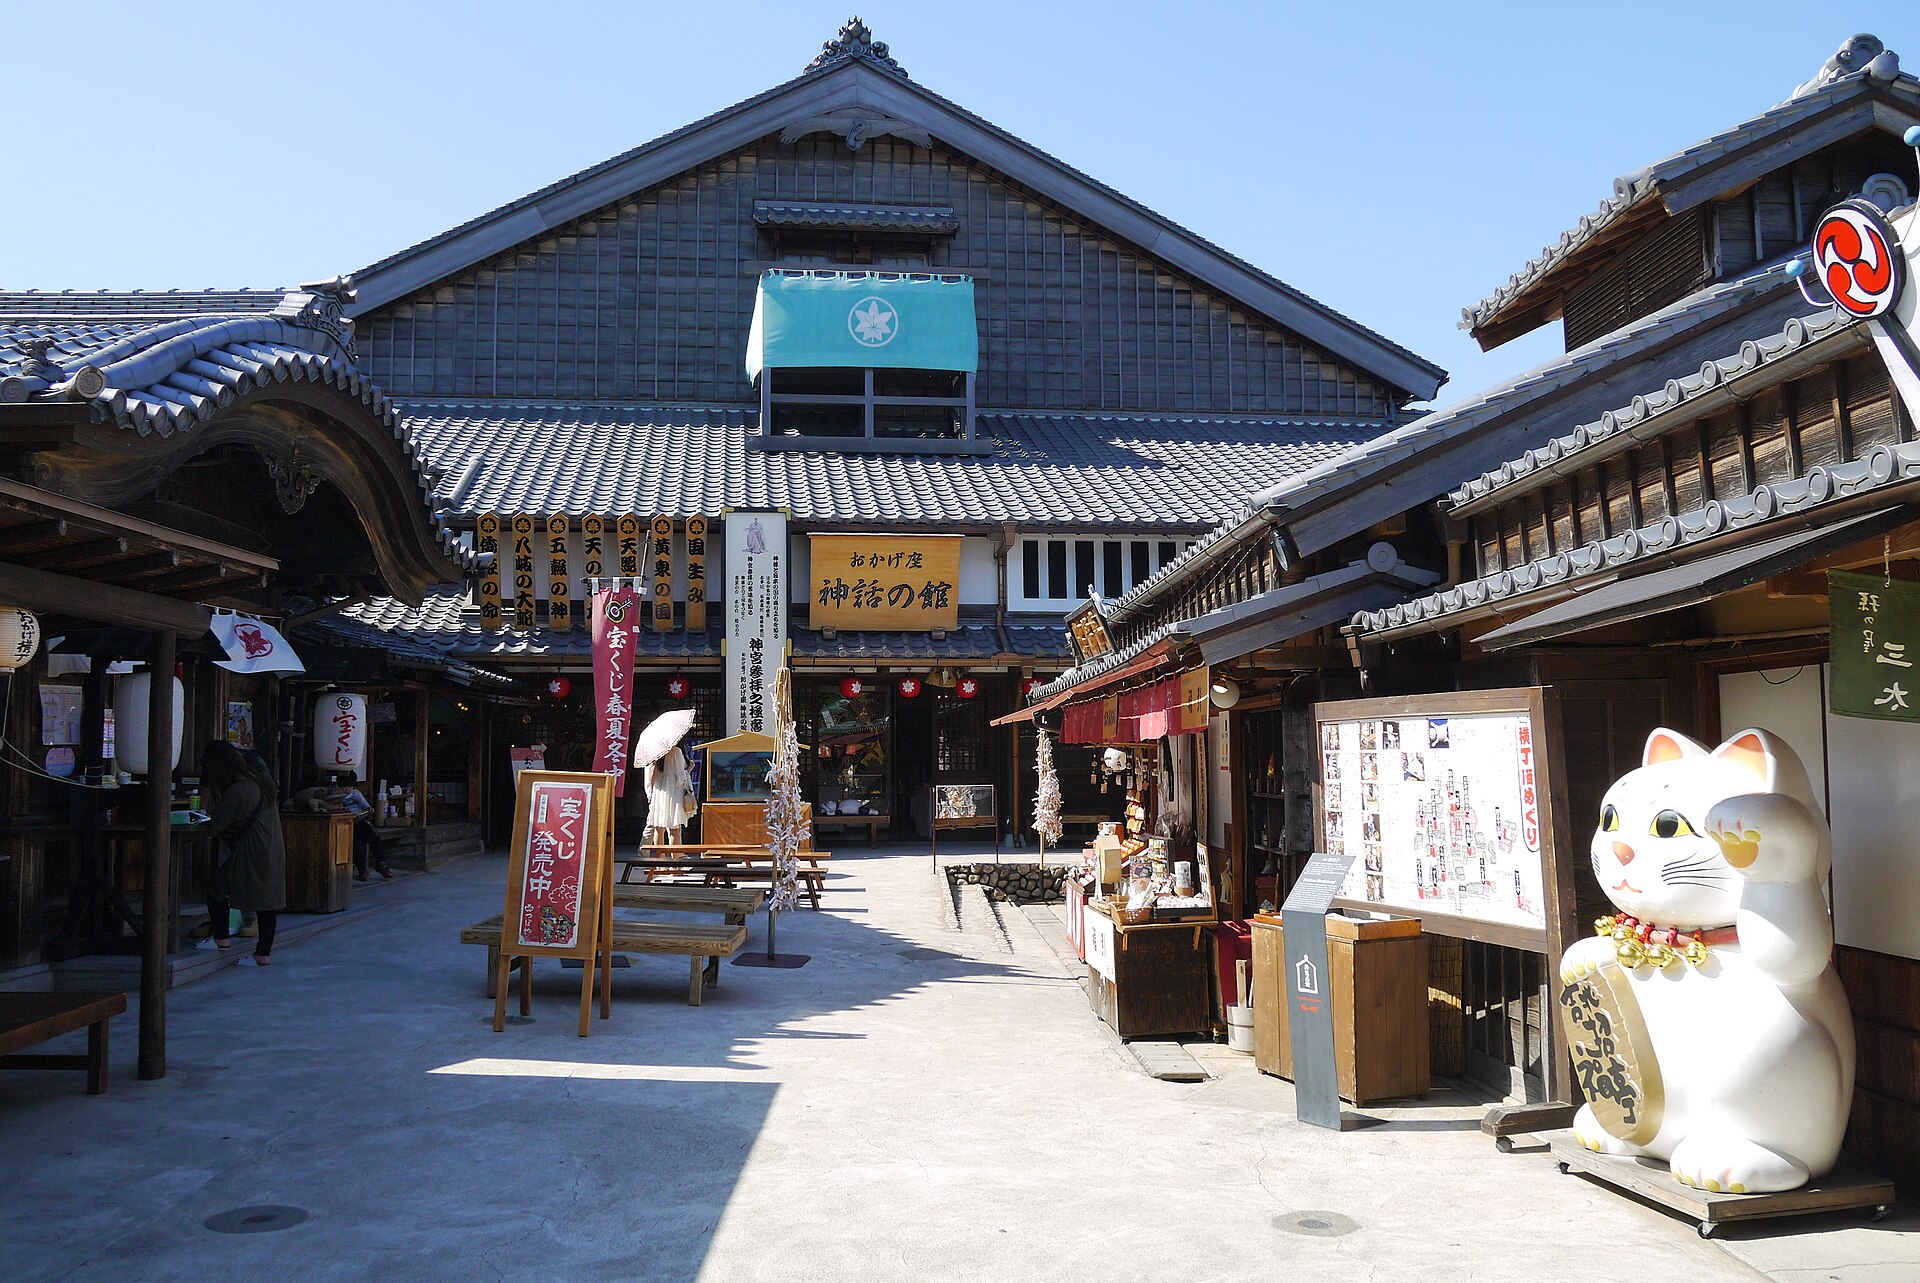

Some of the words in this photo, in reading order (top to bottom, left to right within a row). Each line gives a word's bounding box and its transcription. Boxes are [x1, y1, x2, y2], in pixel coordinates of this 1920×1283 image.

[850, 551, 923, 570] おかげ座
[818, 578, 953, 610] 神話の館
[14, 608, 35, 662] おかげ横丁
[333, 711, 357, 766] 宝くじ
[557, 796, 582, 860] 宝くじ
[529, 831, 558, 899] 発売中
